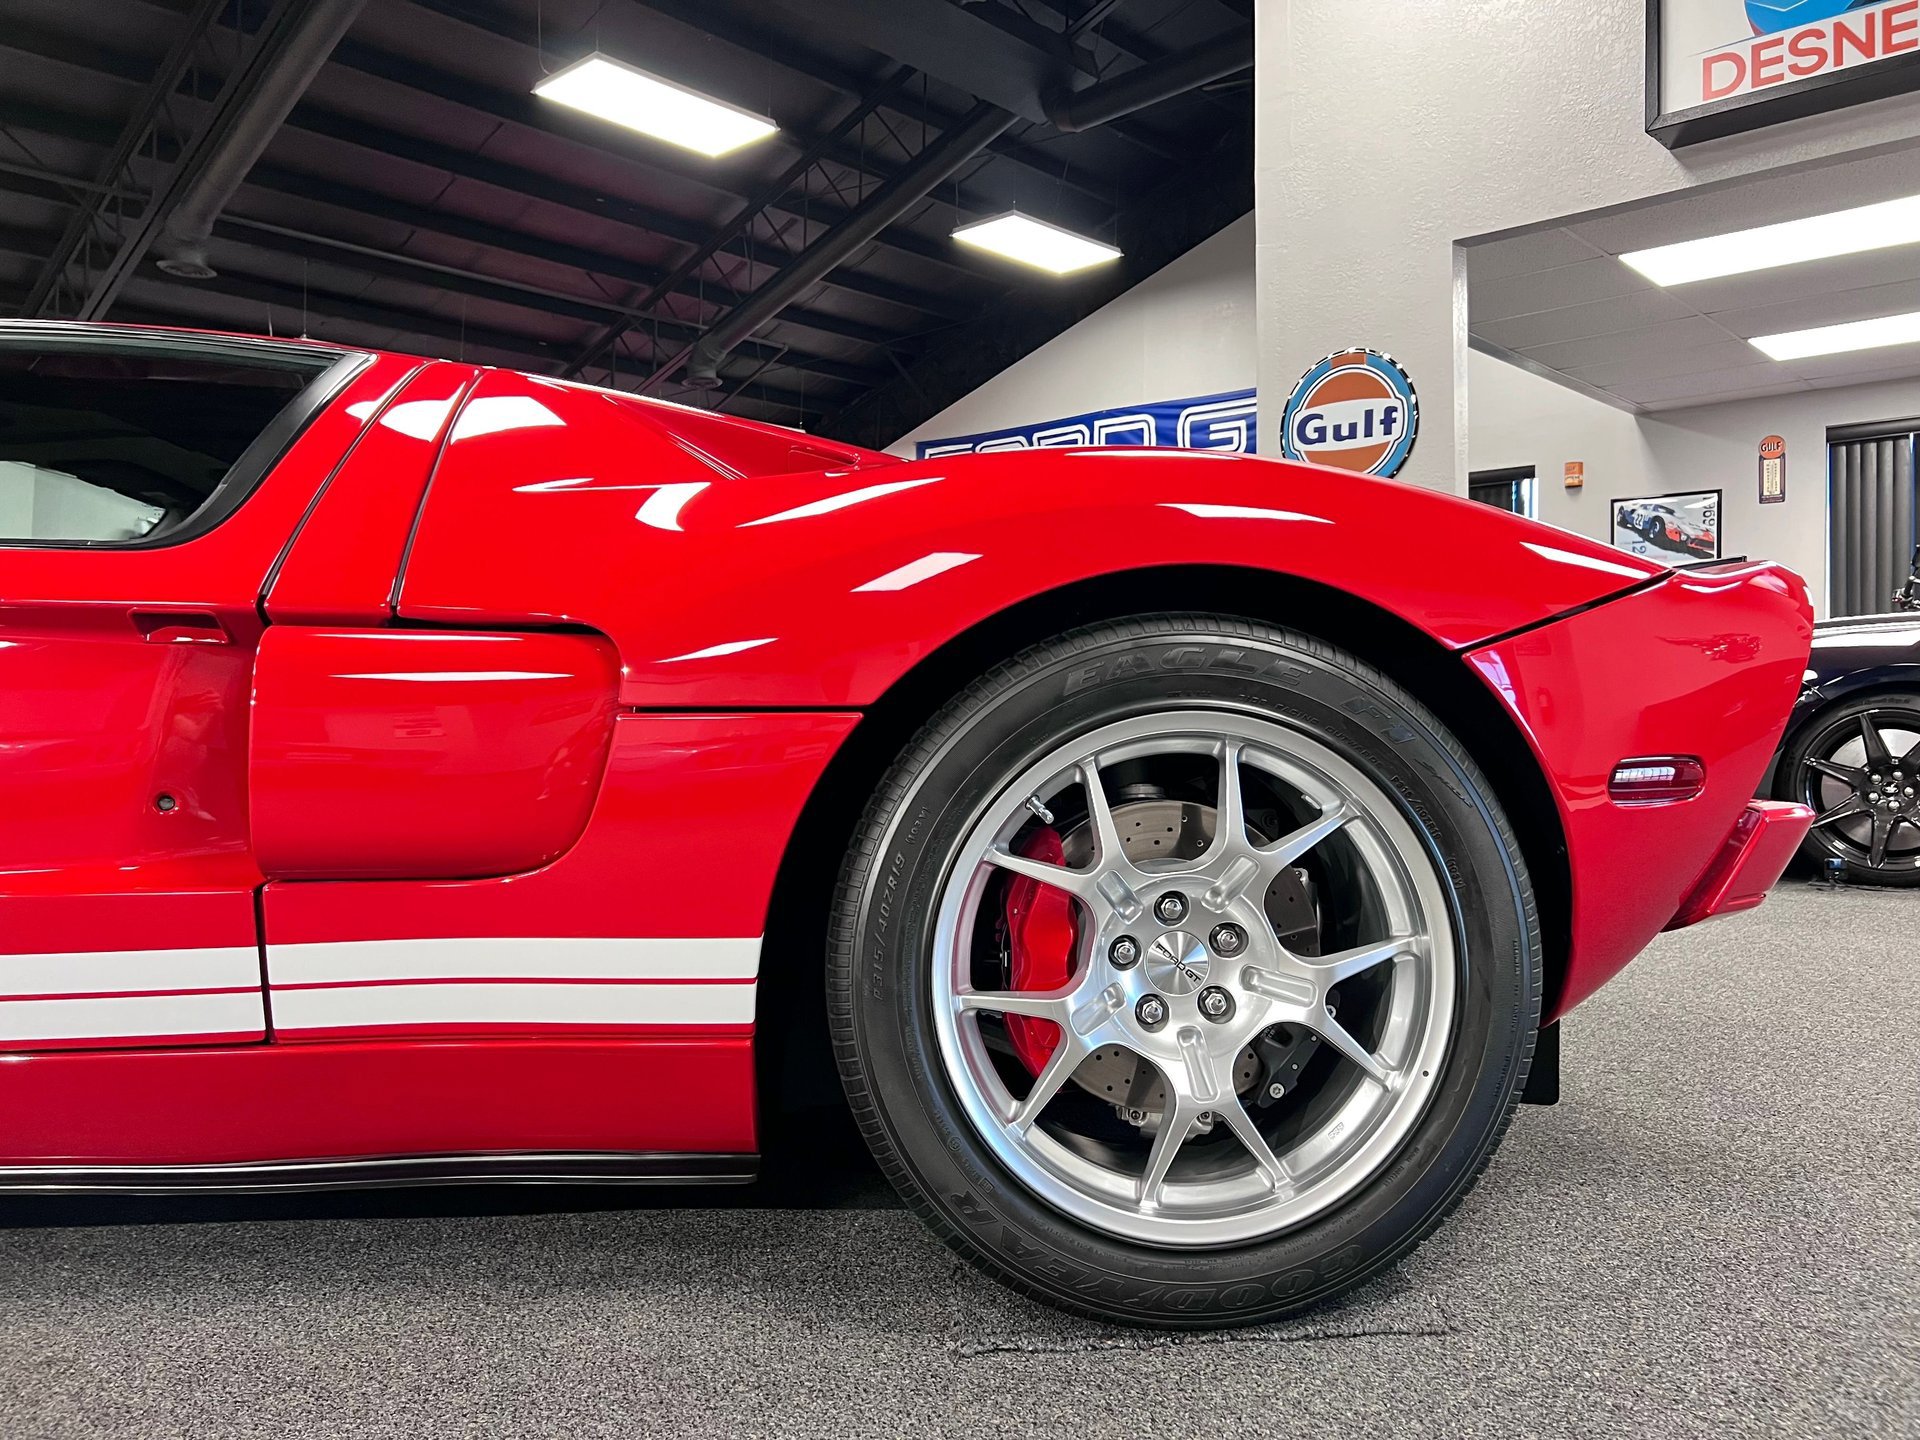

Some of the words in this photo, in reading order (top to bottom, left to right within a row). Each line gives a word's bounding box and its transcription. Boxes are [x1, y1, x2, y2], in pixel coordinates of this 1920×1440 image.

[1703, 0, 1919, 101] DESNE
[1297, 406, 1398, 445] Gulf
[1761, 441, 1782, 452] GULF
[1063, 646, 1313, 687] EAGLE
[873, 853, 905, 1000] P315/40ZR19
[1155, 943, 1186, 972] FORD
[1185, 969, 1202, 983] GT
